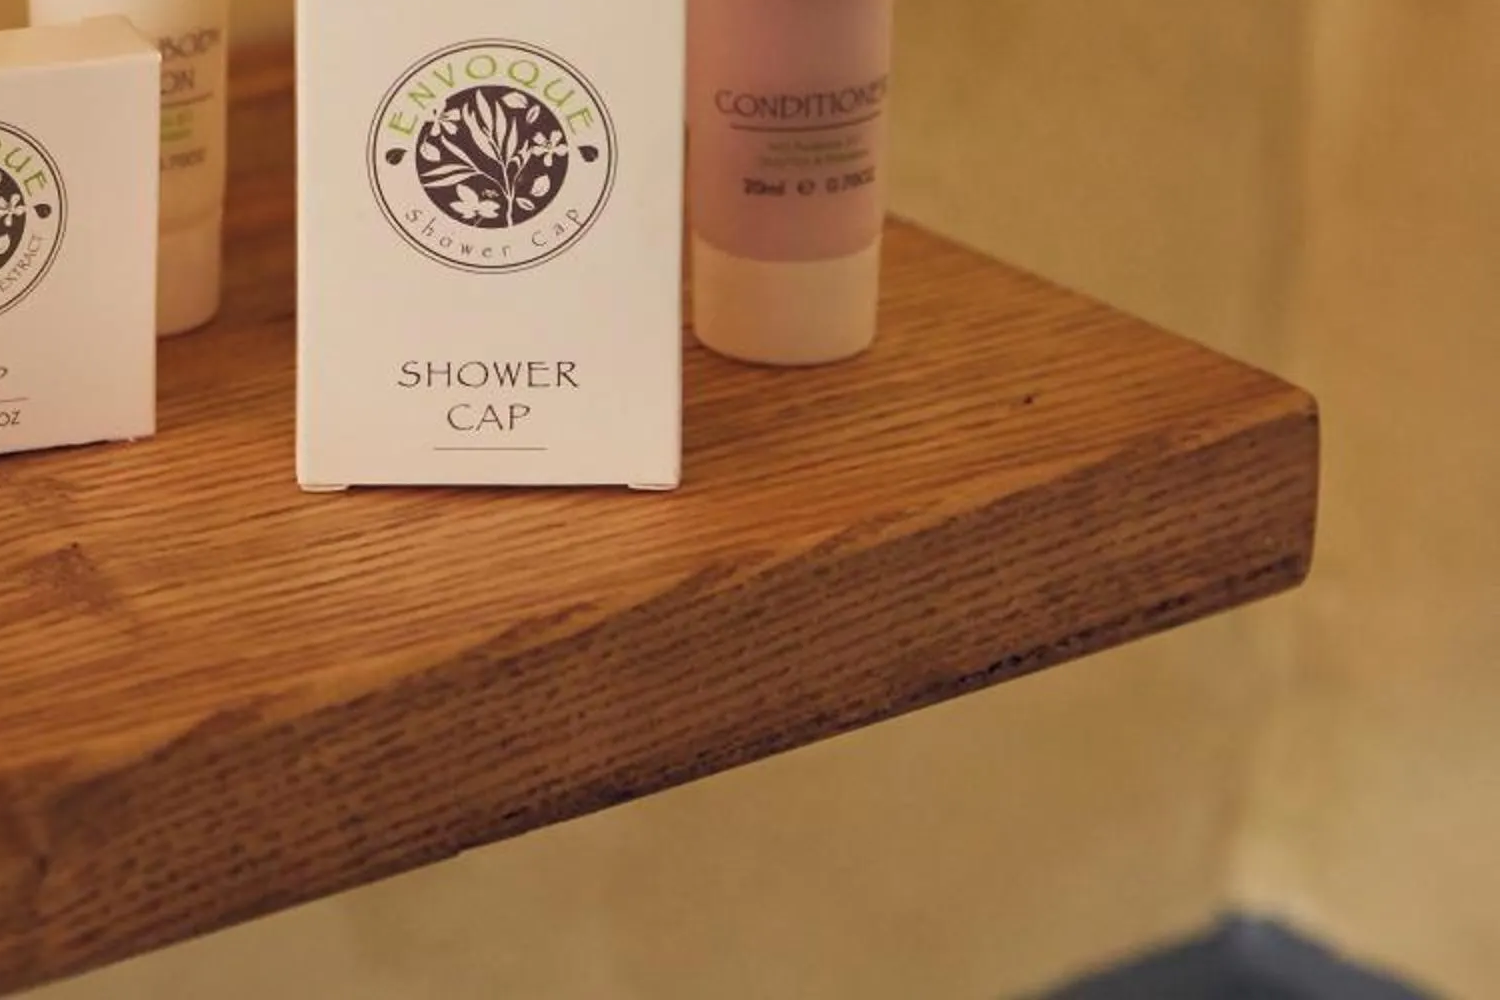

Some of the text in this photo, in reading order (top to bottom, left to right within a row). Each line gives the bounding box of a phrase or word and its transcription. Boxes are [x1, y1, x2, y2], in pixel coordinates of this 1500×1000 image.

[387, 54, 595, 137] ENVOQUE
[404, 207, 586, 258] Shower Cap
[397, 359, 580, 389] SHOWER
[446, 402, 532, 432] CAP
